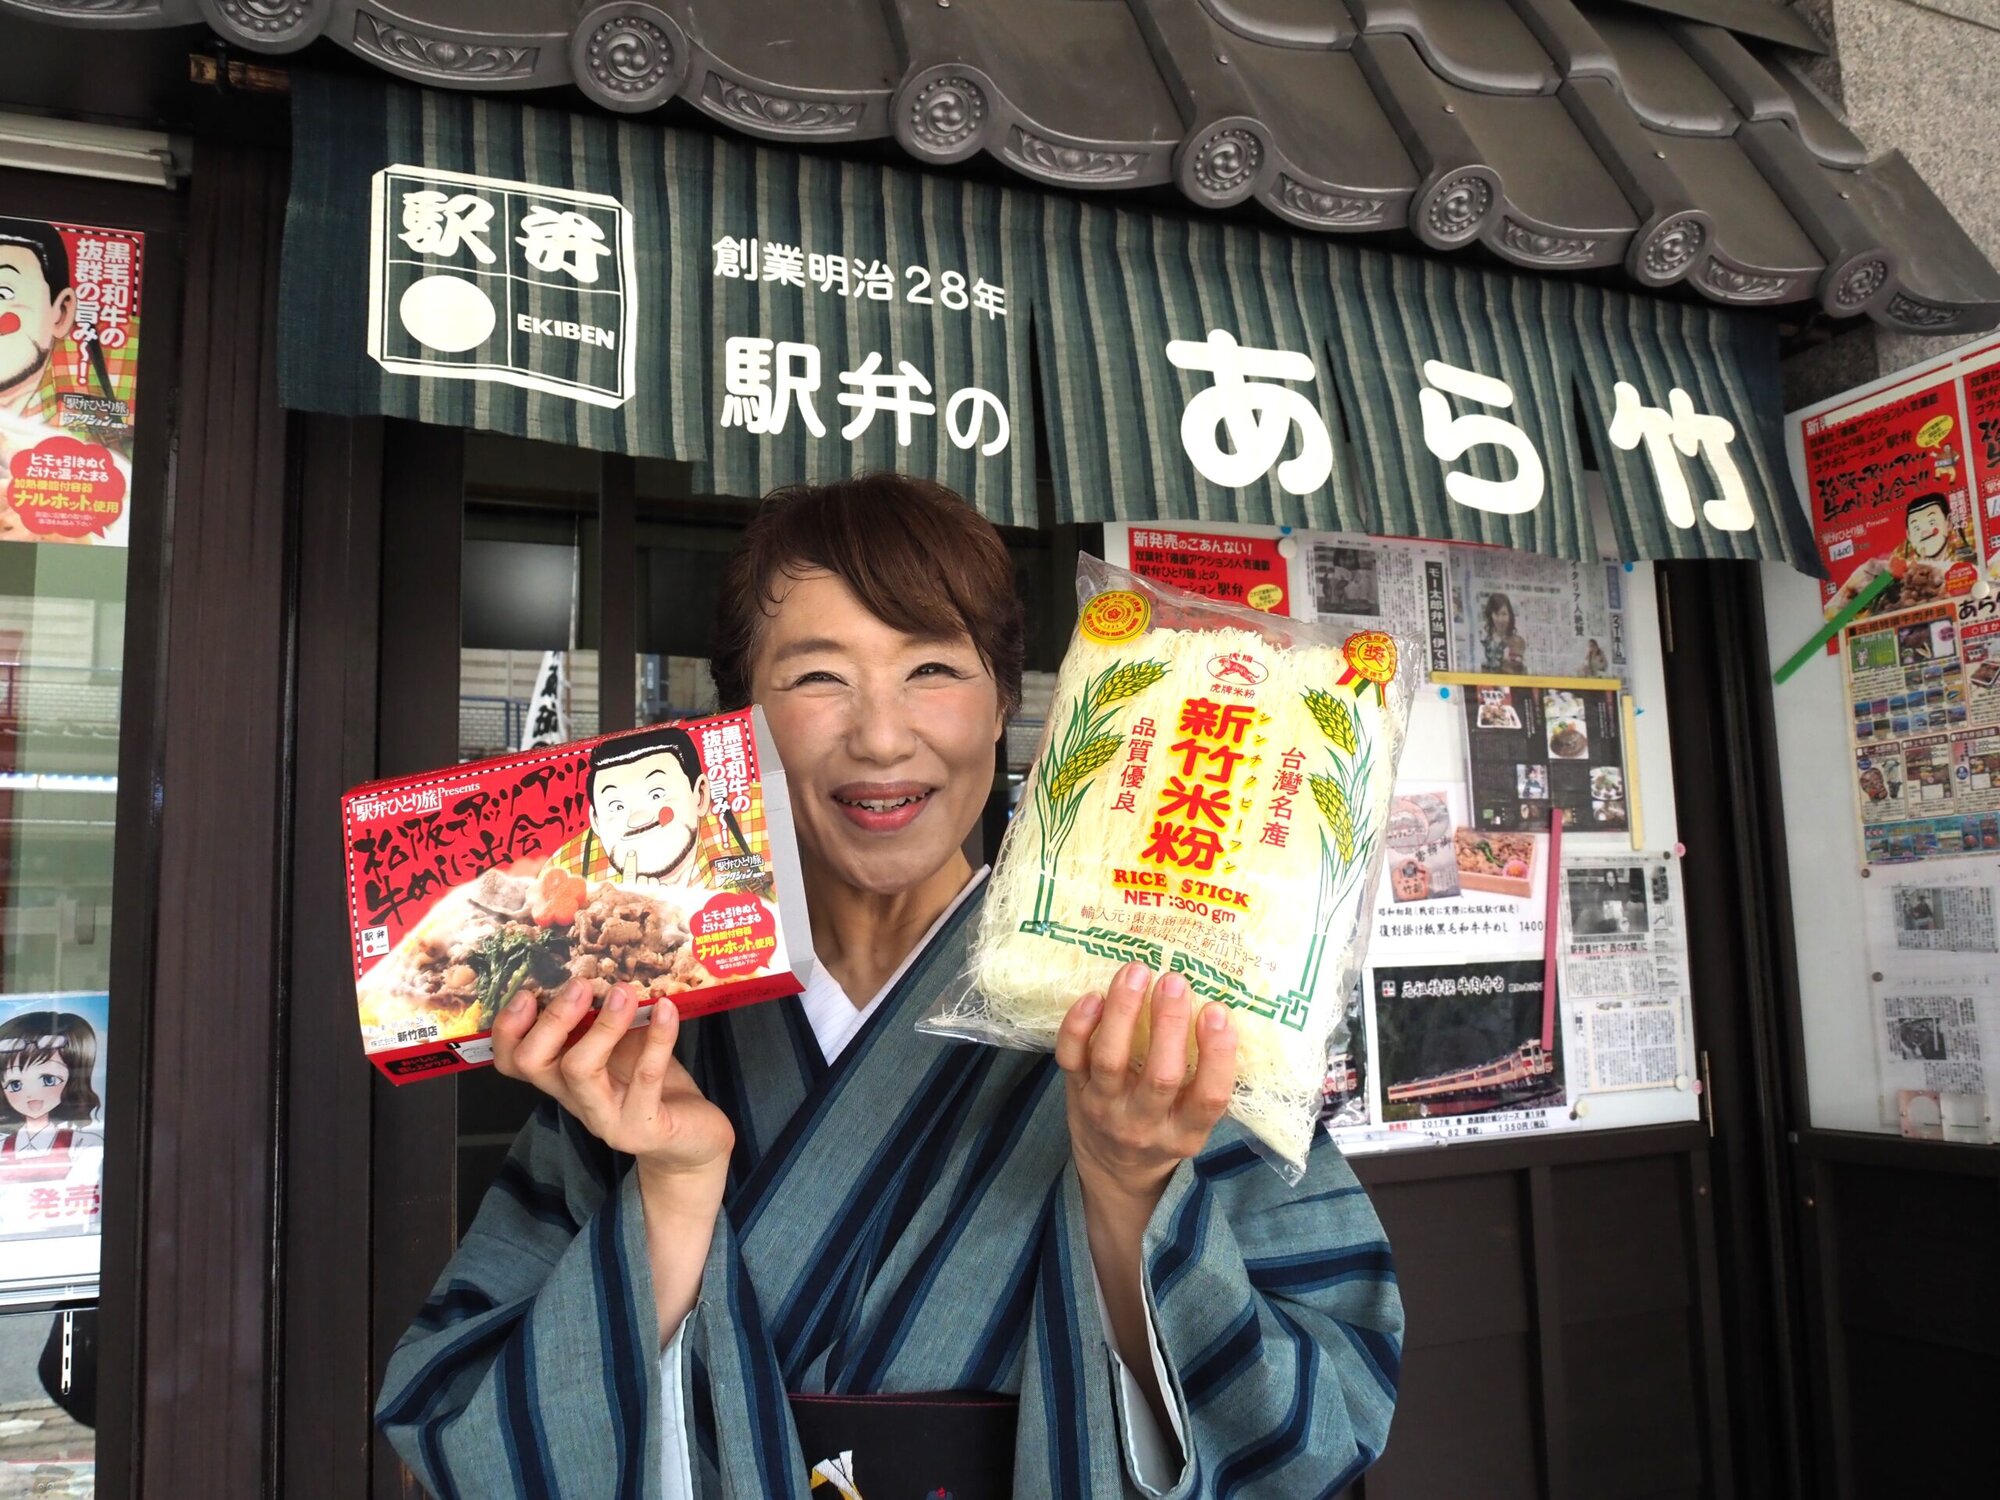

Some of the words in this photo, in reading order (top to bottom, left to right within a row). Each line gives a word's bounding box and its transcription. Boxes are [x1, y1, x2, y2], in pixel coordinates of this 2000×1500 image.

[101, 240, 130, 348] 黒毛和牛の
[712, 234, 1009, 321] 創業明治28年
[517, 312, 615, 351] EKIBEN
[719, 336, 1011, 458] 駅弁の
[31, 453, 106, 470] ヒモを引きぬく
[1209, 683, 1256, 700] 虎牌米粉
[721, 724, 751, 812] 黒毛和牛の
[1141, 697, 1256, 873] 新竹米粉
[438, 781, 481, 799] Presents
[1113, 868, 1168, 888] RICE
[1181, 878, 1250, 908] STICK
[1124, 889, 1165, 907] NET
[1211, 908, 1237, 925] gm
[28, 1184, 100, 1220] 発売
